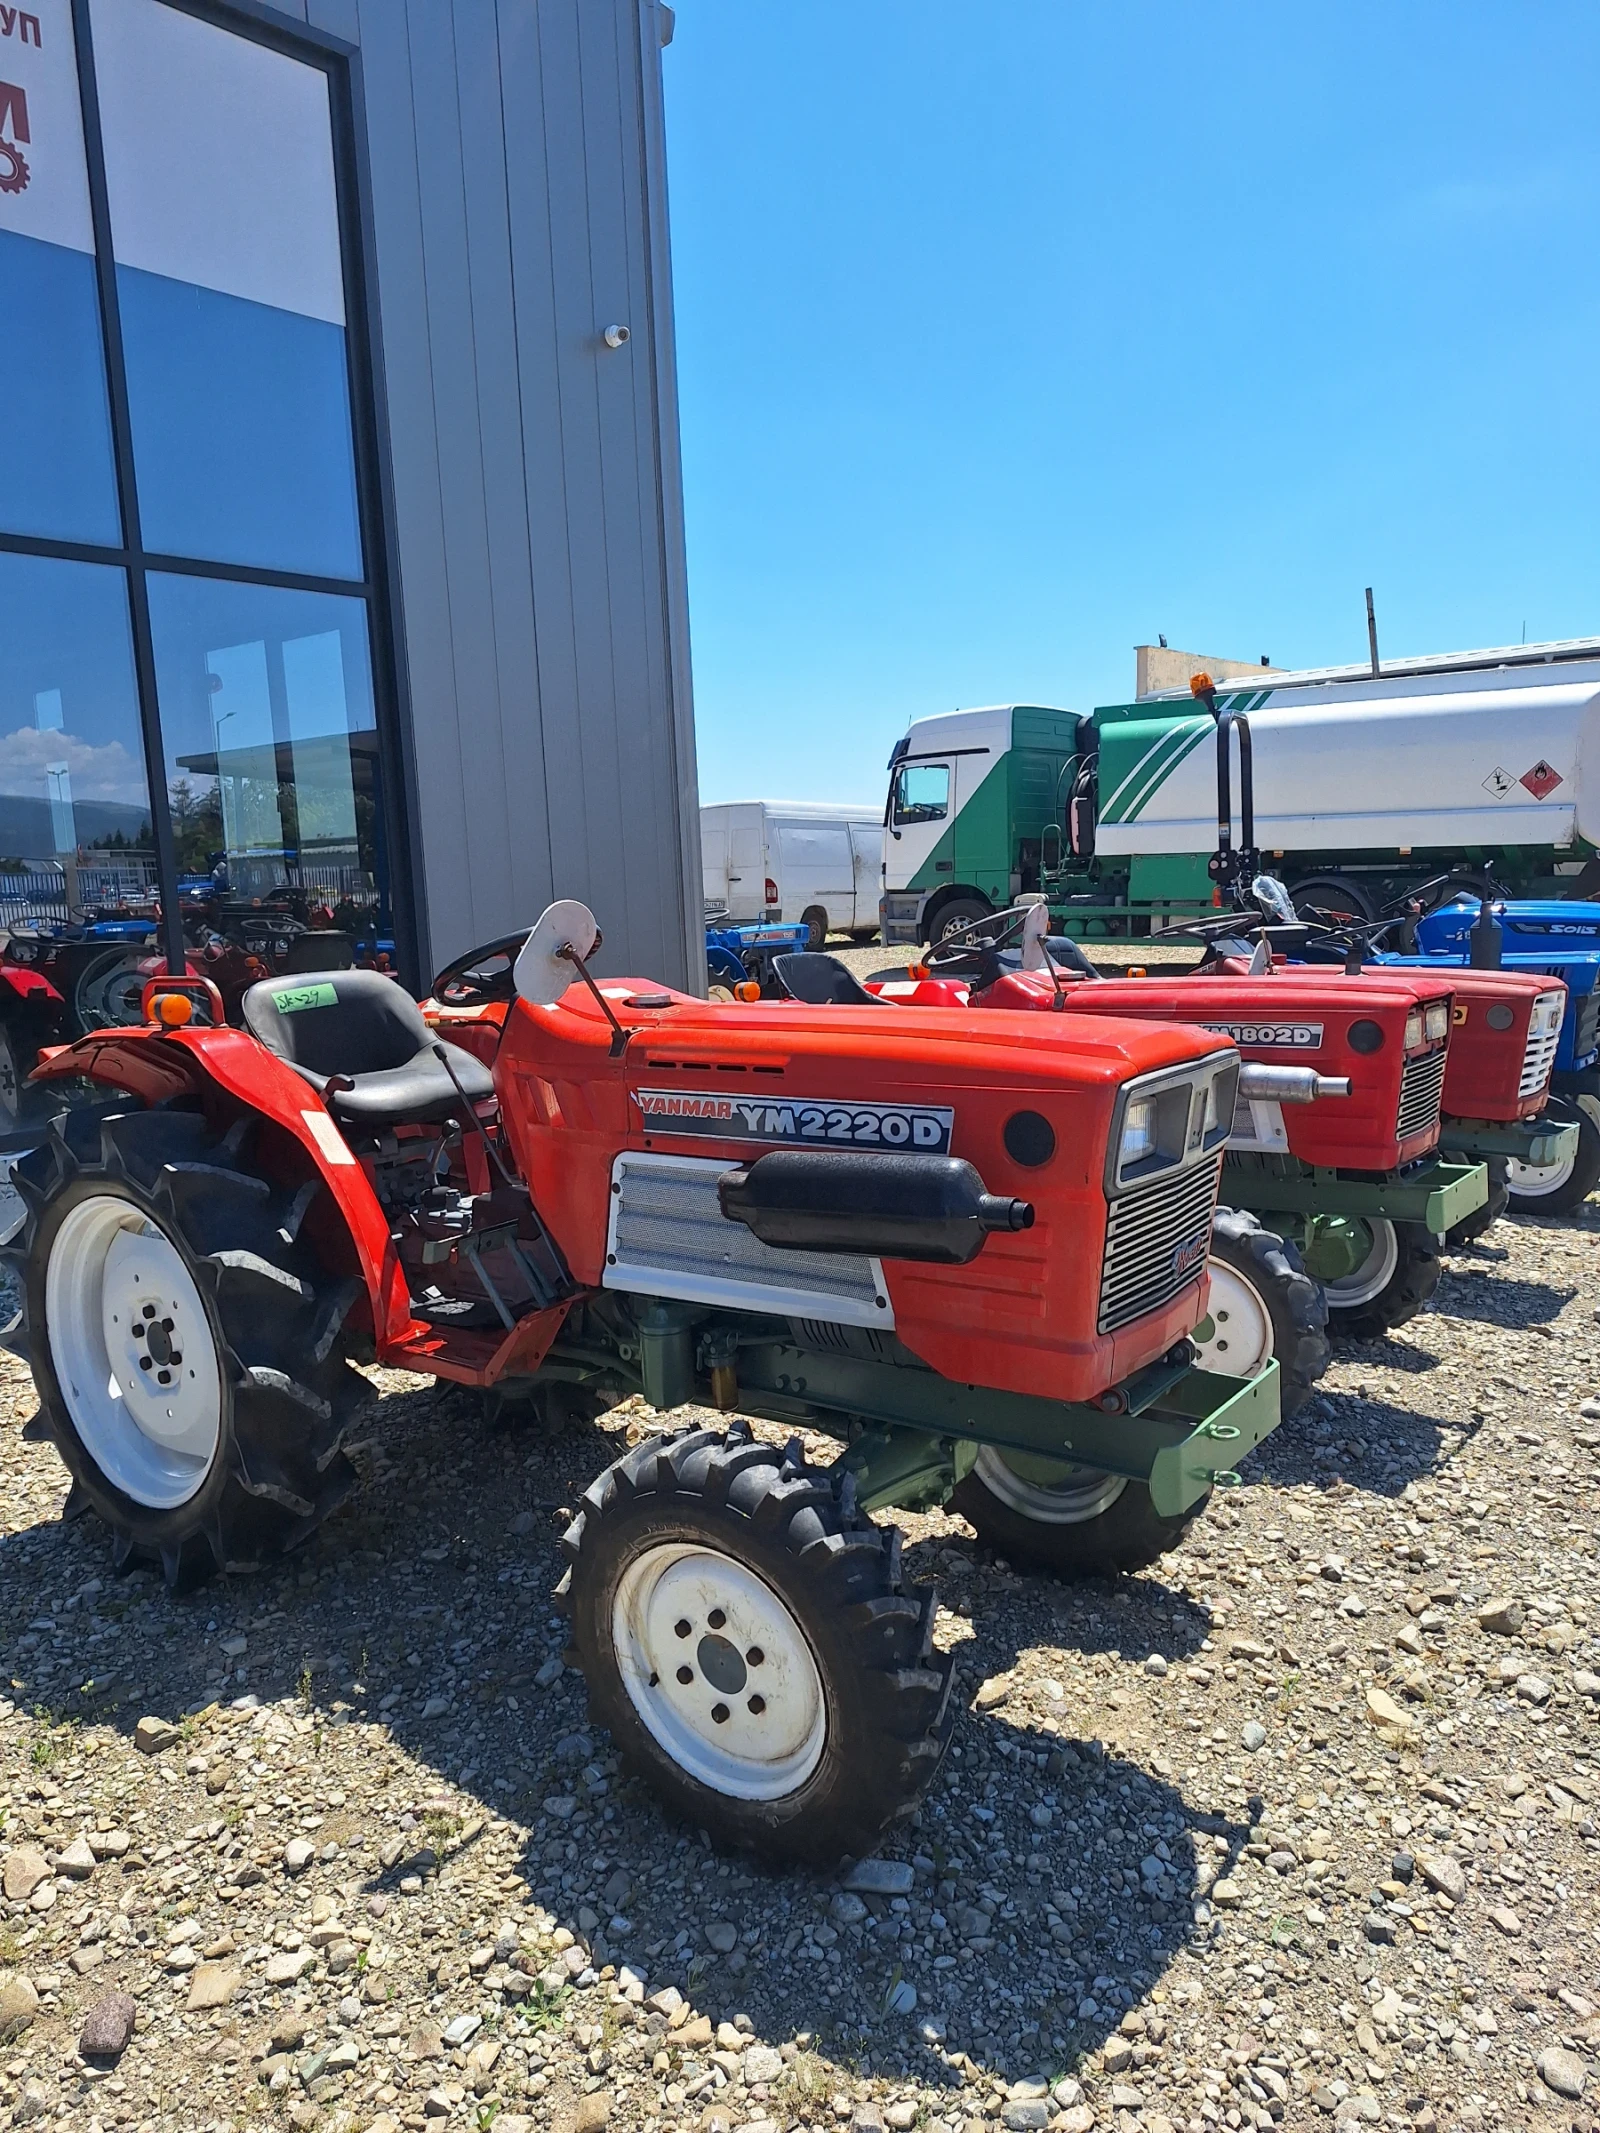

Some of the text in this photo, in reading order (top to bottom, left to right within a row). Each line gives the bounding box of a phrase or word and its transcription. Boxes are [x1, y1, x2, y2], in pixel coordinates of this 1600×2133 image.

[1203, 1026, 1311, 1043] 1802D
[641, 1096, 943, 1147] YANMAR YM2220D
